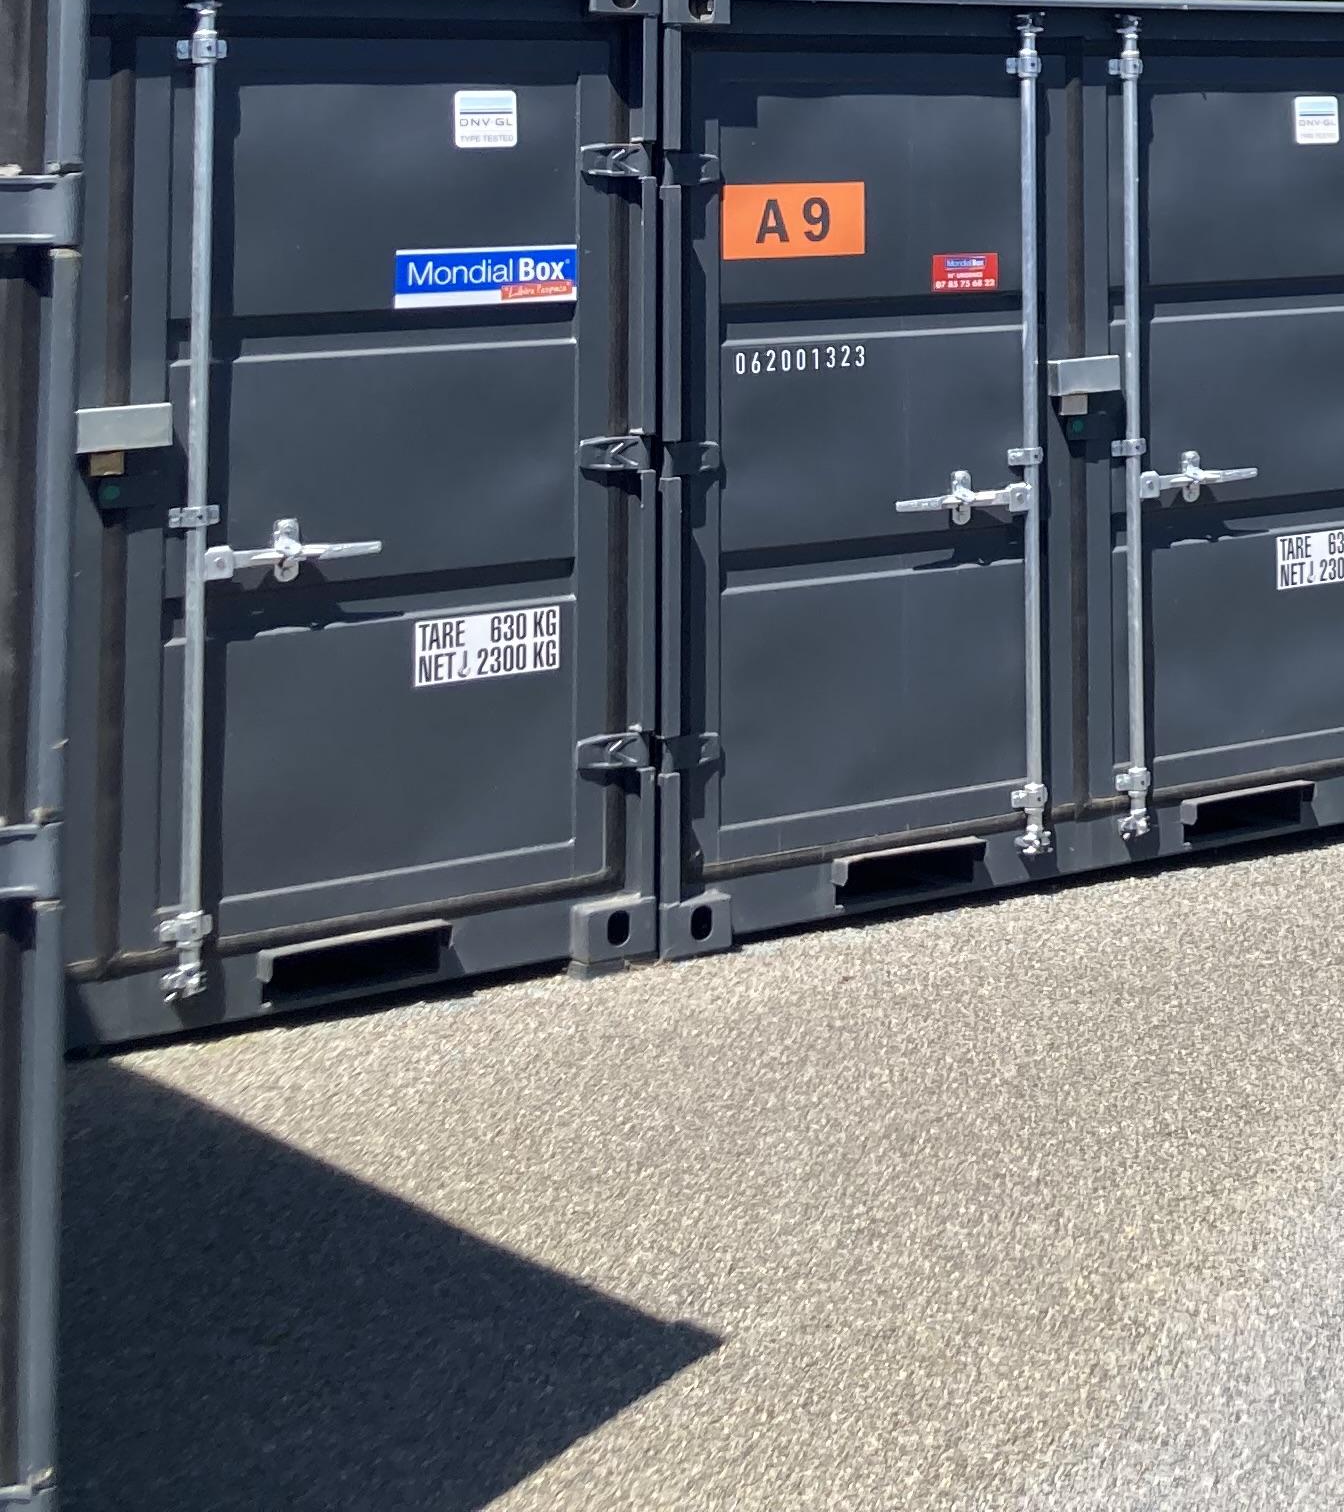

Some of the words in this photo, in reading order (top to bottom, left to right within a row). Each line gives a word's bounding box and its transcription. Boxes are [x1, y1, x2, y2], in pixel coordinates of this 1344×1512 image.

[460, 135, 481, 143] TYPE
[484, 134, 514, 143] TESTED
[736, 345, 865, 375] 062001323
[1280, 536, 1312, 561] TARE
[1280, 561, 1306, 587] NET
[418, 620, 465, 651] TARE
[490, 613, 527, 643] 630
[533, 609, 556, 638] KG
[418, 652, 456, 683] NET
[477, 643, 527, 675] 2300
[533, 640, 556, 669] KG
